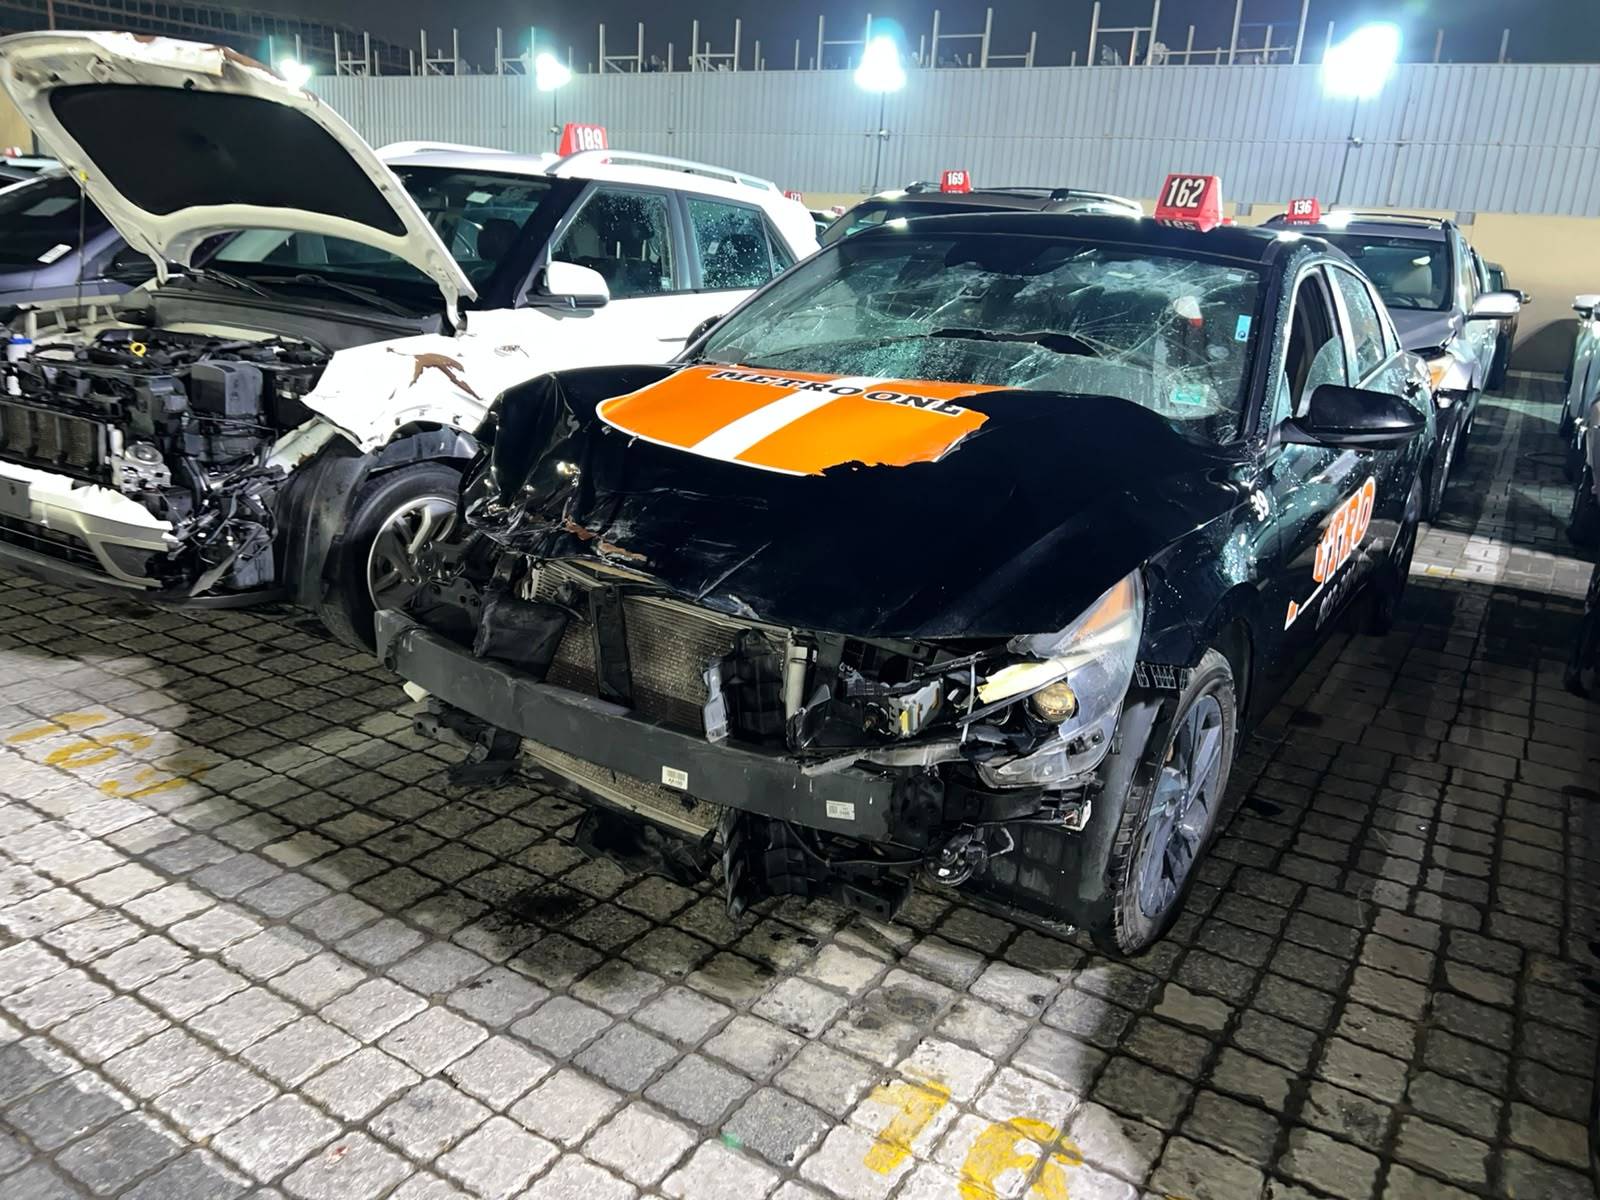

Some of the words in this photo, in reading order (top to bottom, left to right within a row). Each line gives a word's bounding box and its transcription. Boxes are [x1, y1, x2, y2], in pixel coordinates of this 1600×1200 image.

[576, 127, 604, 150] 189
[947, 172, 964, 186] 169
[1165, 177, 1206, 209] 162
[1293, 200, 1313, 215] 136
[708, 370, 865, 396] METRO
[865, 390, 962, 416] ONE
[1250, 489, 1269, 522] 39
[864, 1078, 1191, 1200] 16
